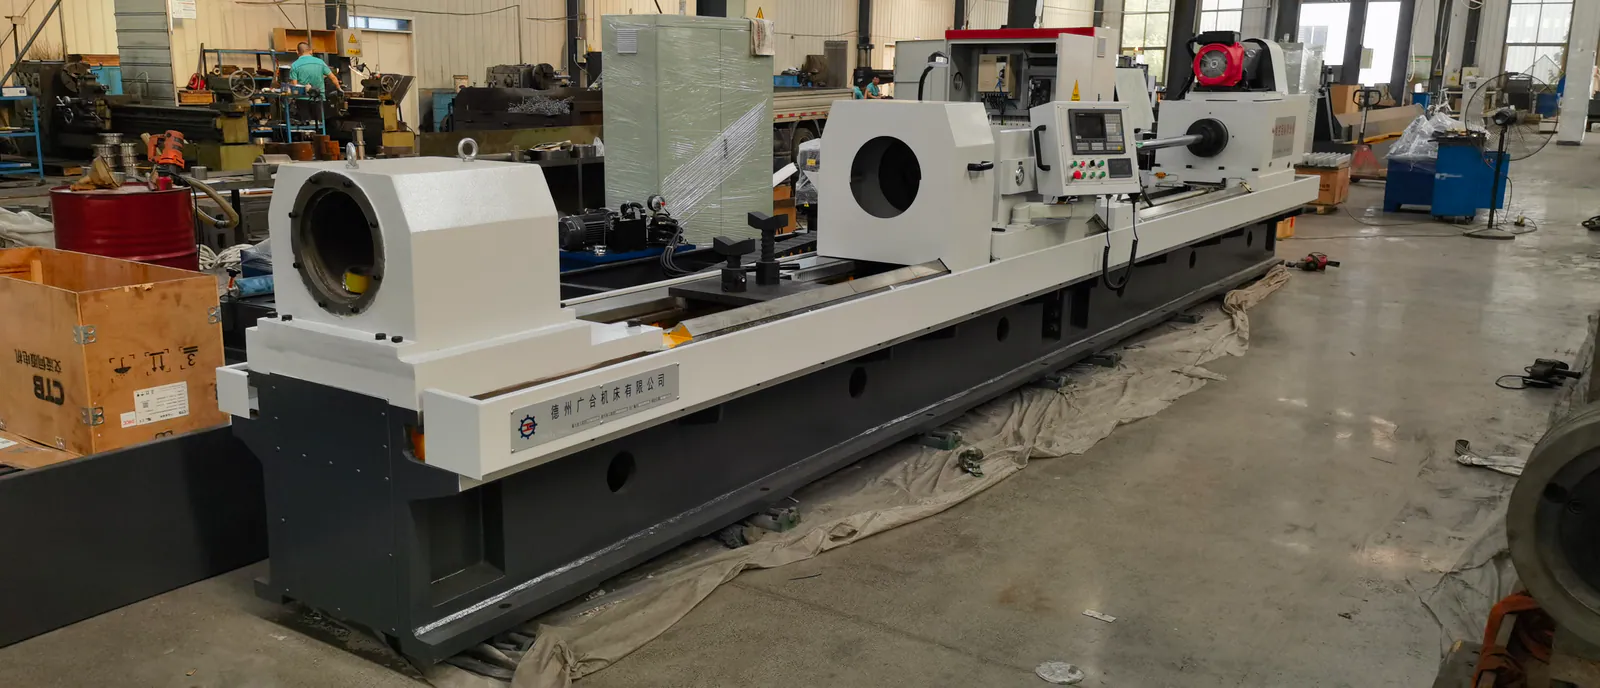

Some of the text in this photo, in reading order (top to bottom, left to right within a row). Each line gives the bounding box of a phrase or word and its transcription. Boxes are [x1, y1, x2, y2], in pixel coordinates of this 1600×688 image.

[187, 353, 196, 366] 3
[33, 375, 65, 406] CTB
[551, 373, 665, 420] 德州广合机床有限公司
